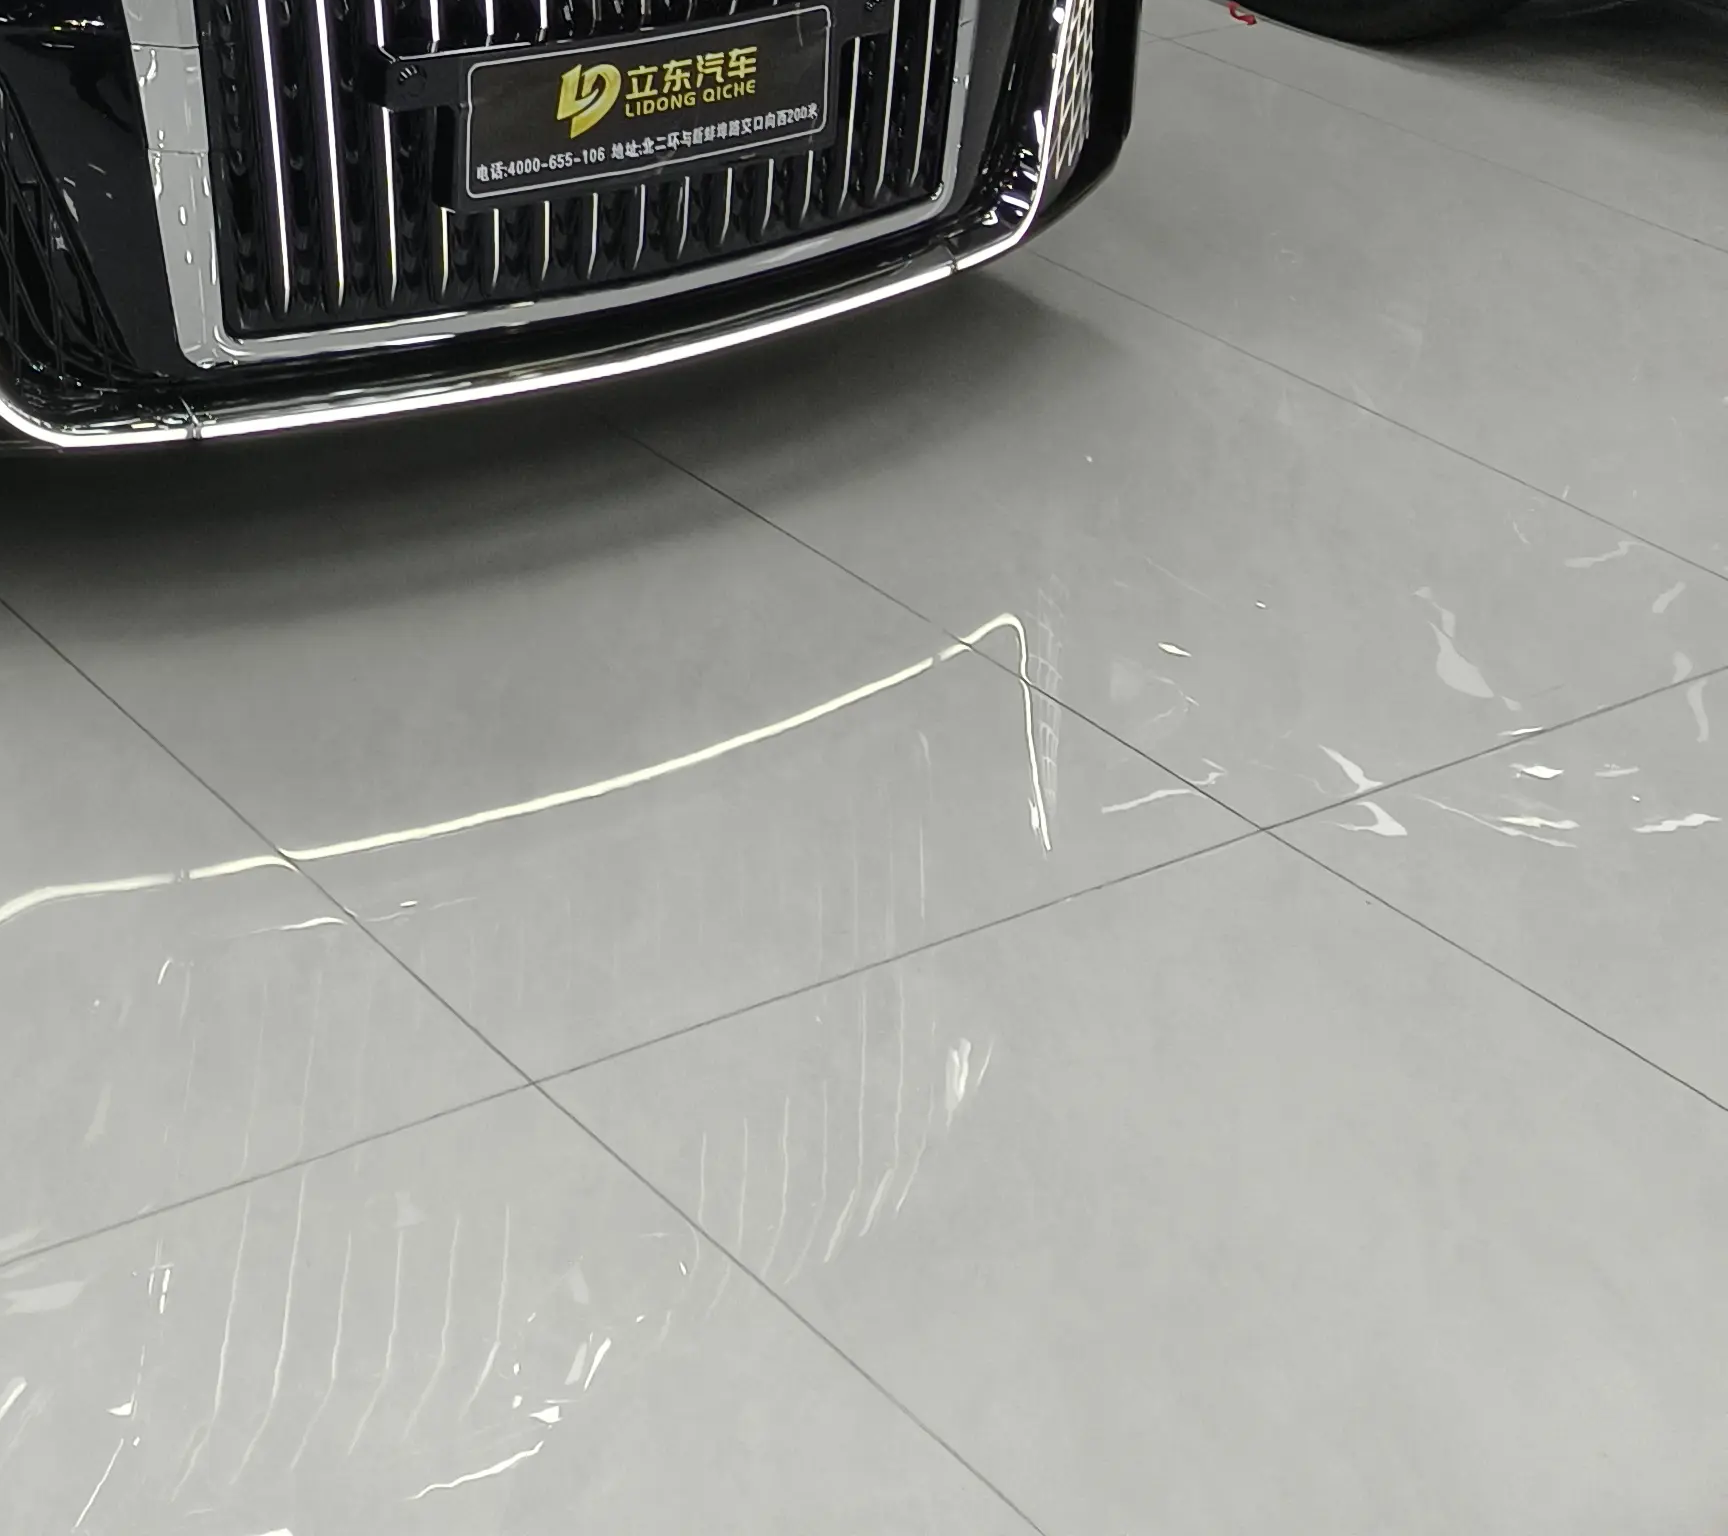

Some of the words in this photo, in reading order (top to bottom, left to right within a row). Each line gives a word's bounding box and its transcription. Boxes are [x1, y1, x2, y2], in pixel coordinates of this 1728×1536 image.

[625, 46, 758, 100] 立东汽车
[624, 91, 697, 118] LIDONG
[702, 78, 757, 103] QICHE
